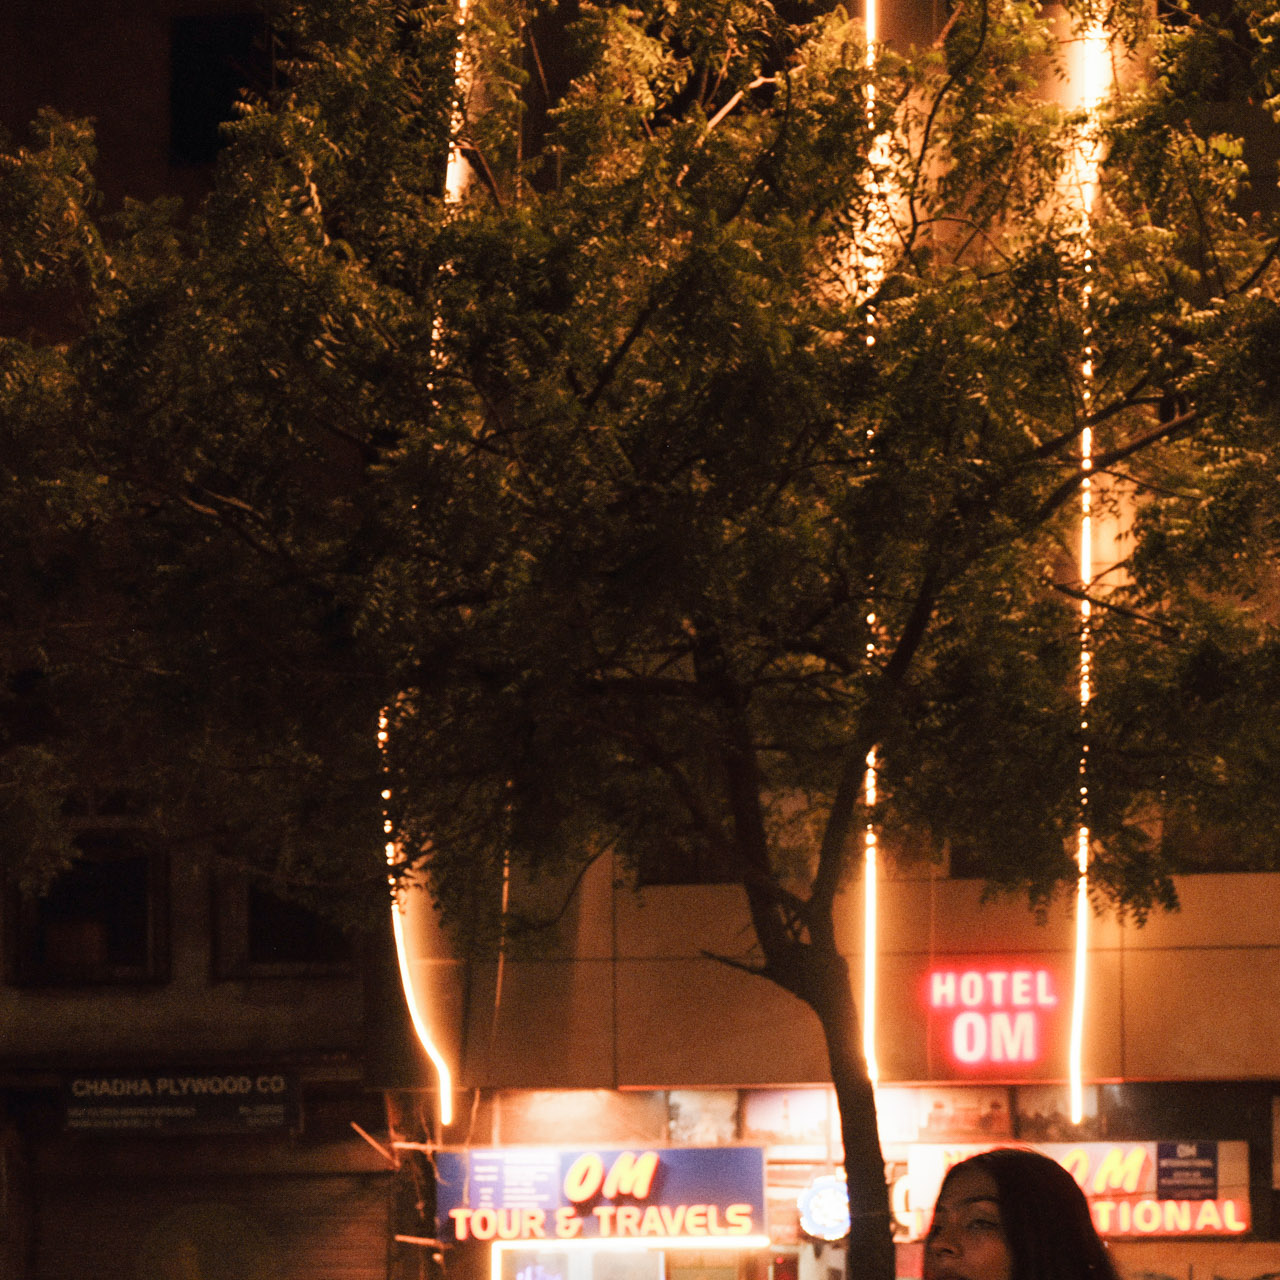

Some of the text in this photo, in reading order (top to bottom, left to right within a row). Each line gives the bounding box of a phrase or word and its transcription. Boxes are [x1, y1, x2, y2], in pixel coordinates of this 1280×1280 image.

[930, 970, 1057, 1008] HOTEL
[953, 1010, 1036, 1064] OM
[72, 1074, 286, 1097] CHADHA PLYWOOD CO
[563, 1150, 660, 1203] OM
[449, 1203, 753, 1241] TOUR & TRAVELS
[1094, 1200, 1248, 1233] TIONAL
